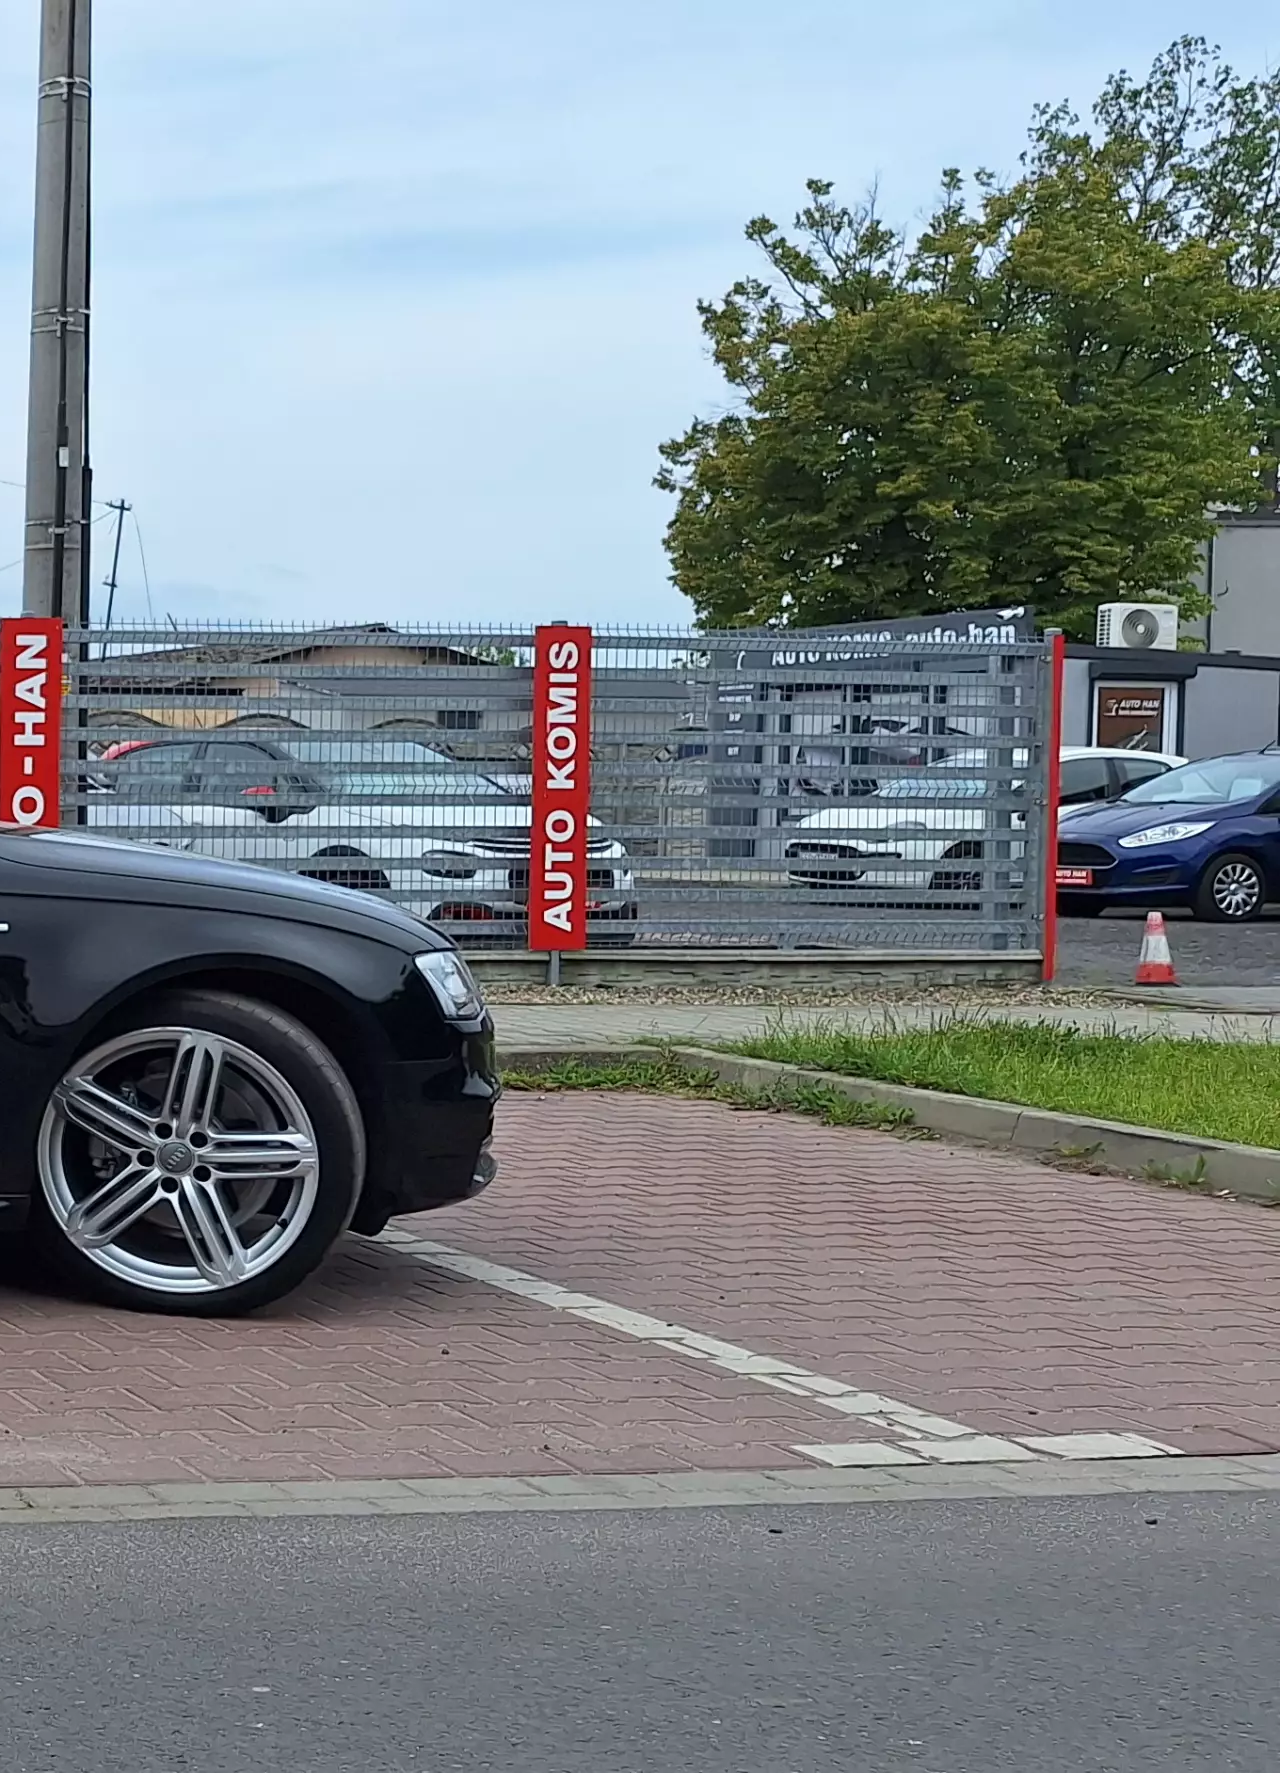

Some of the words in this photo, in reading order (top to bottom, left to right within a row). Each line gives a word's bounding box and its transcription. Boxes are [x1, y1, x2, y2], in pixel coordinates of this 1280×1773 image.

[546, 641, 579, 790] KOMIS
[1119, 699, 1141, 709] AUTO
[543, 809, 576, 932] AUTO
